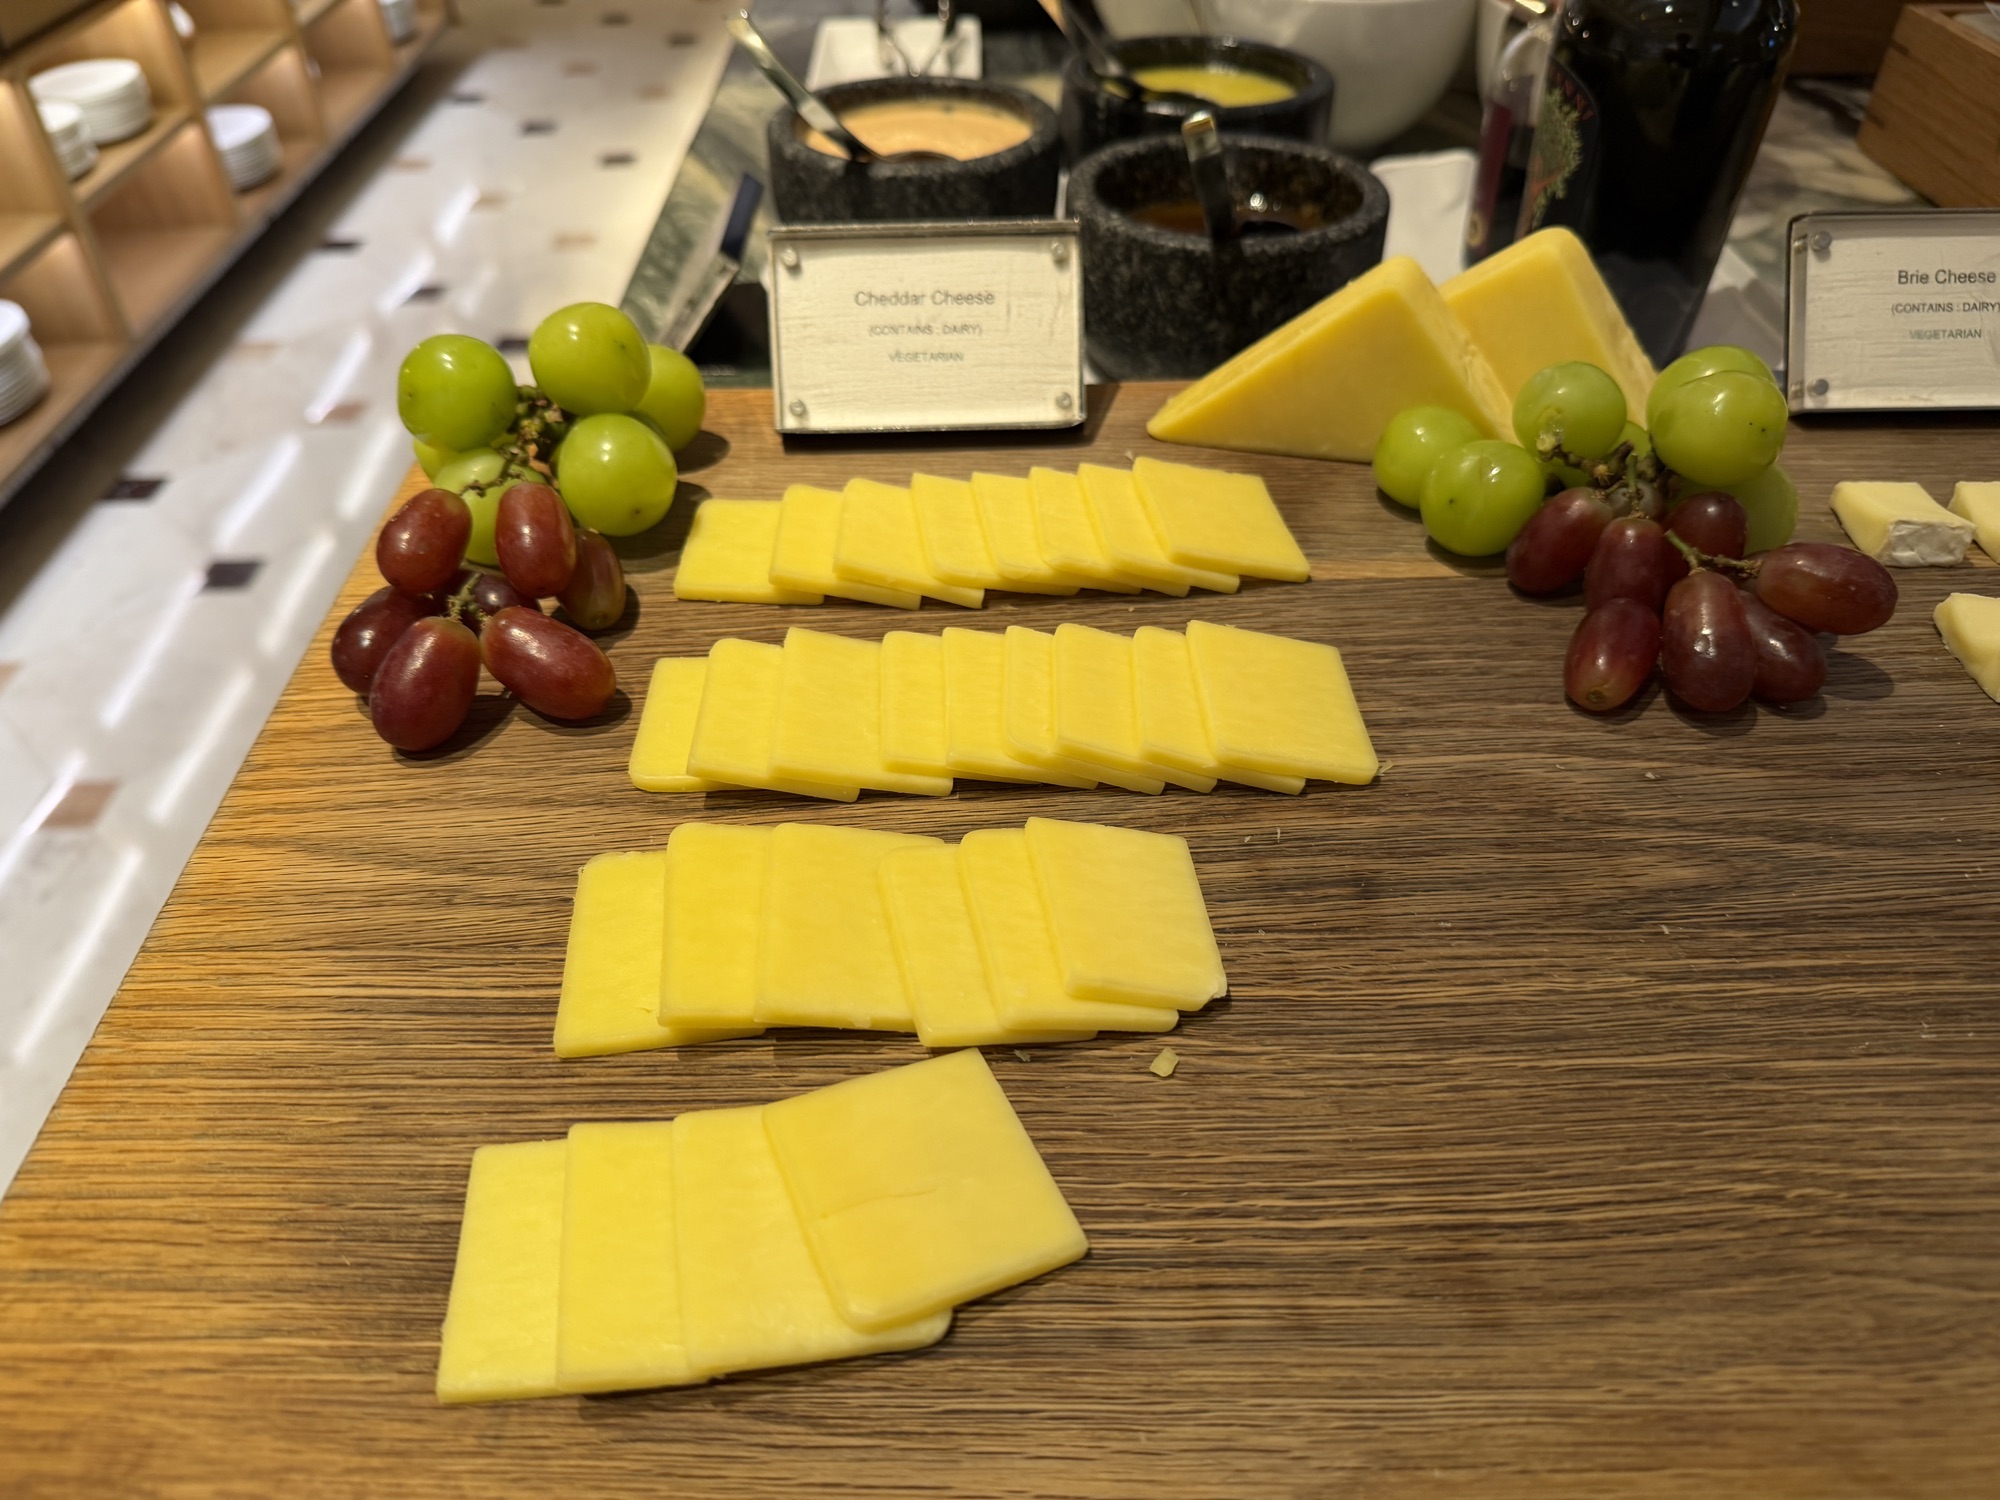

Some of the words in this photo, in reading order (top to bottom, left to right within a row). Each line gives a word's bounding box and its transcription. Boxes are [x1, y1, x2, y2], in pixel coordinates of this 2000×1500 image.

[1898, 270, 1929, 284] Brie
[1935, 269, 1997, 284] Cheese
[854, 291, 925, 307] Cheddar
[931, 290, 996, 306] Cheese
[1909, 329, 1982, 340] VEGETARIAN
[888, 352, 964, 363] VEGETARIAN
